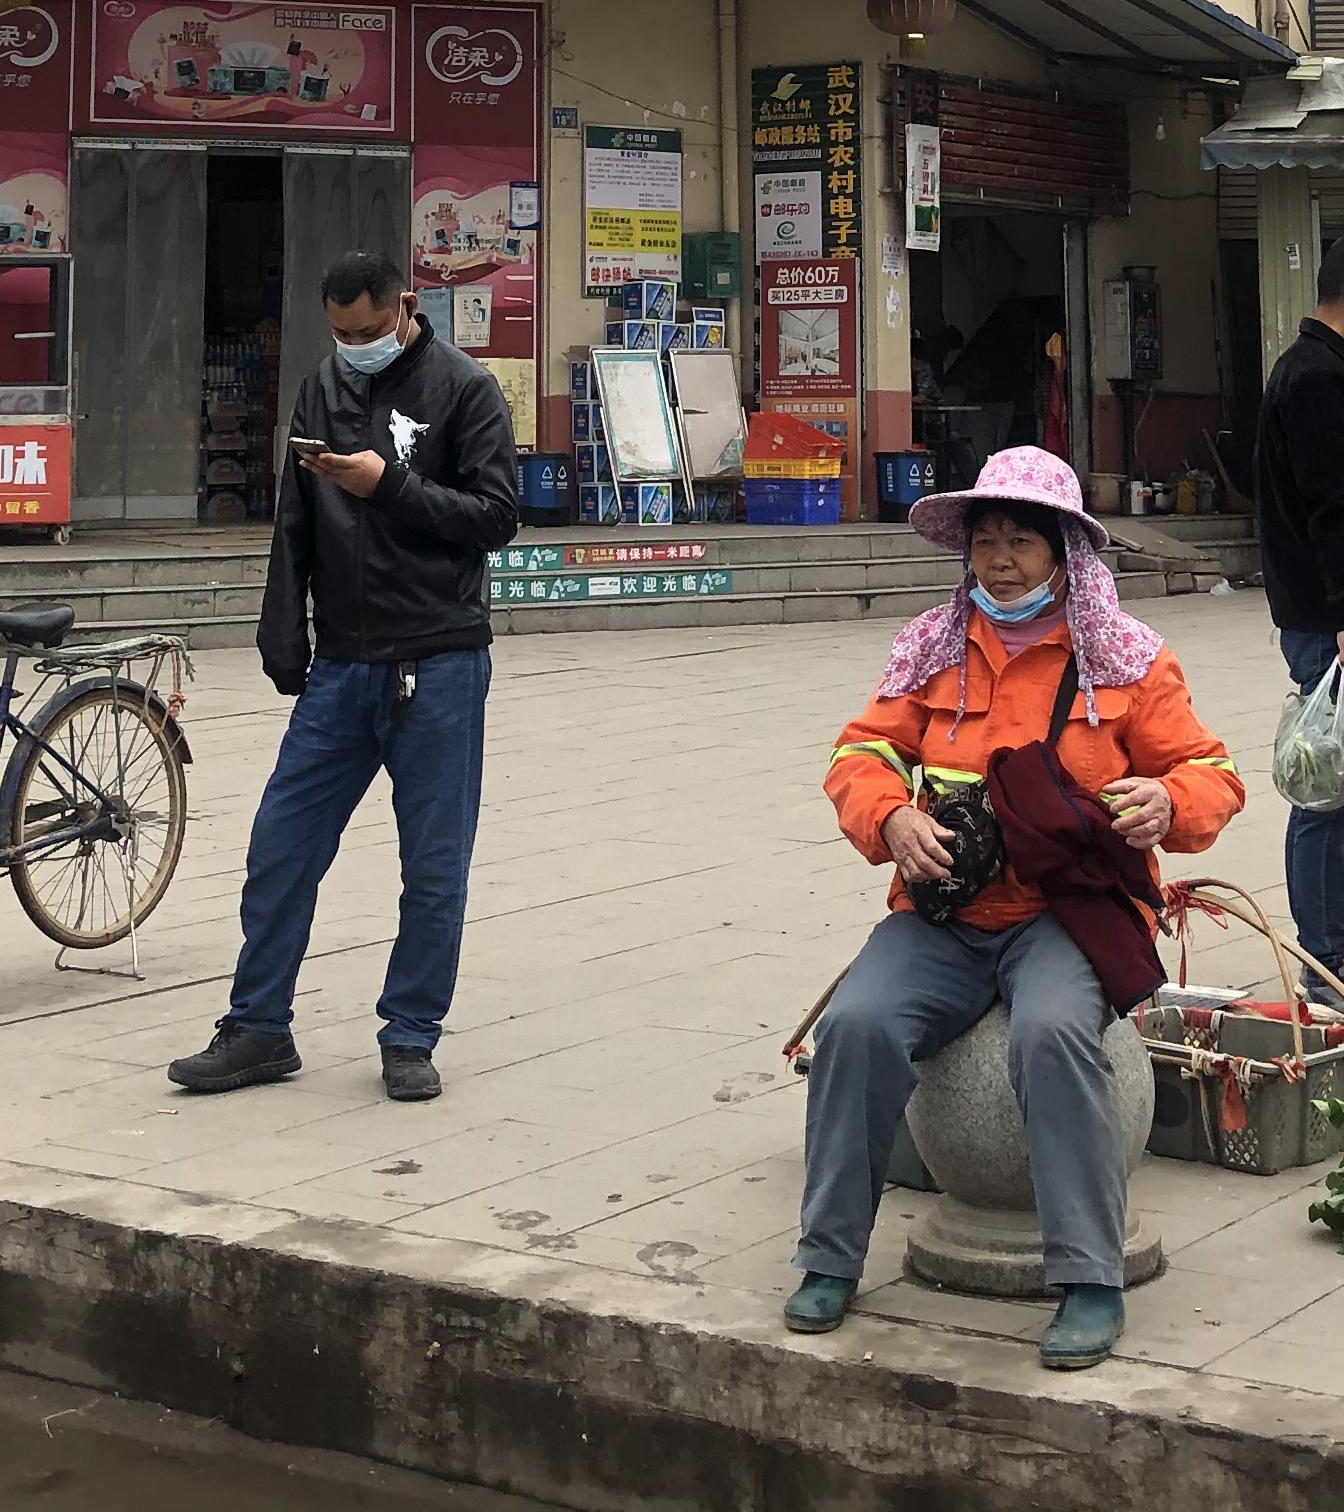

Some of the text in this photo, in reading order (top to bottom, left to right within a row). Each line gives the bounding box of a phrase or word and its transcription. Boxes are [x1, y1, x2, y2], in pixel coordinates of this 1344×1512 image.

[443, 40, 490, 67] 洁柔
[776, 266, 840, 285] 总价60万
[615, 544, 705, 562] 请保持一米距离
[622, 574, 697, 595] 欢迎光临
